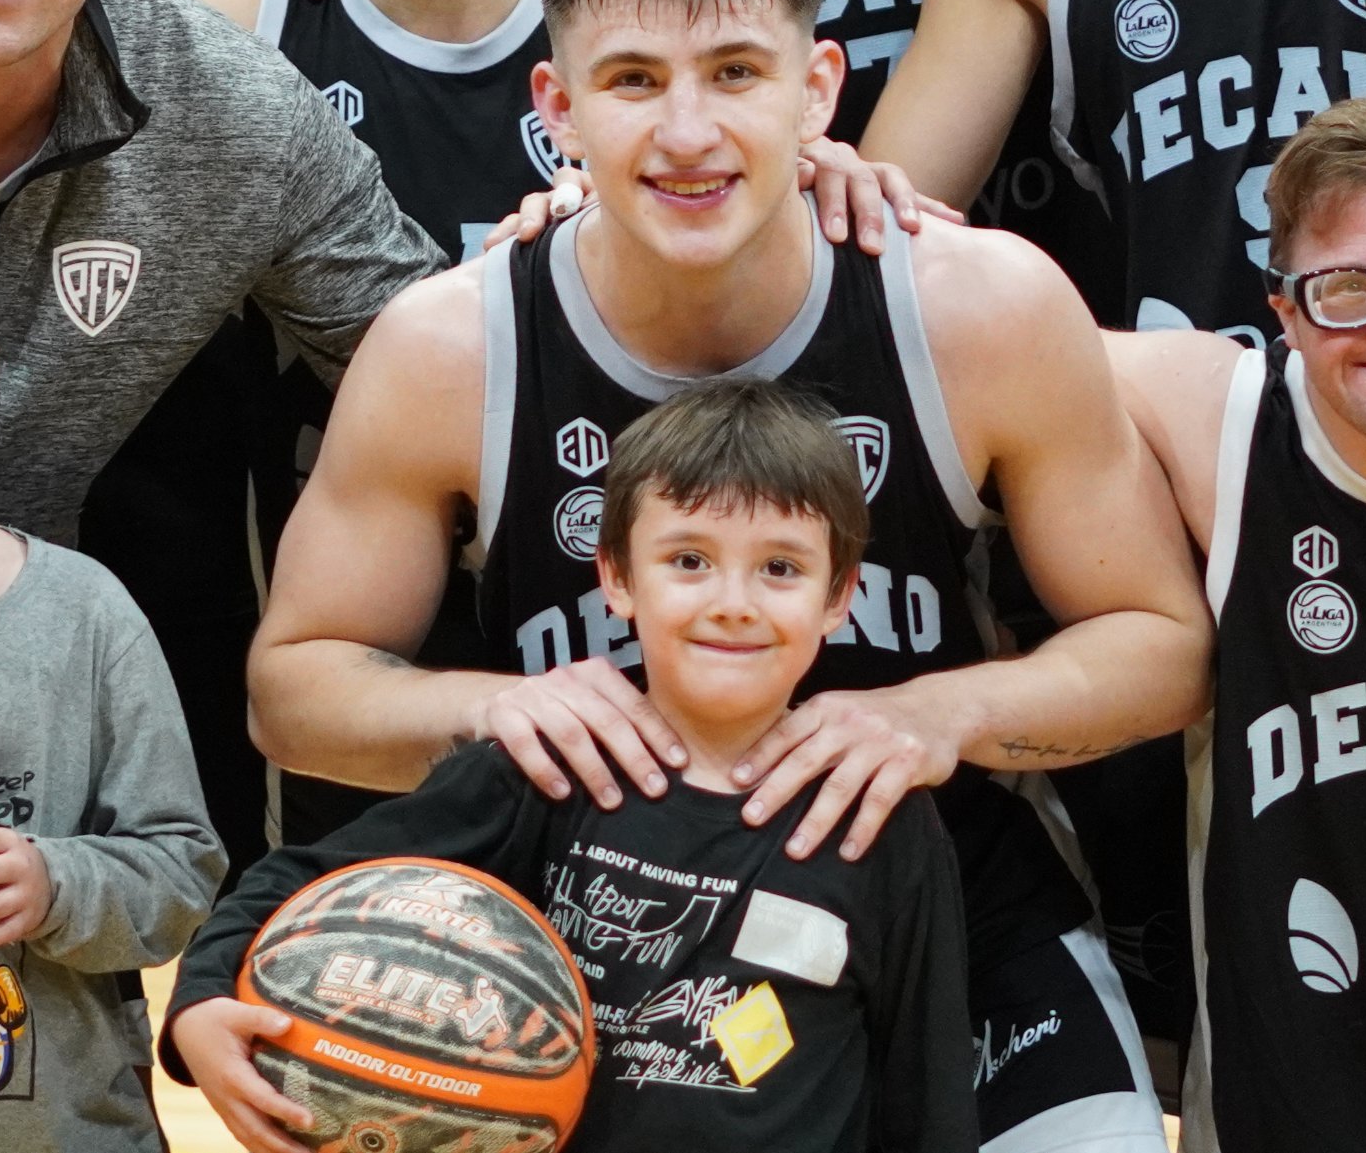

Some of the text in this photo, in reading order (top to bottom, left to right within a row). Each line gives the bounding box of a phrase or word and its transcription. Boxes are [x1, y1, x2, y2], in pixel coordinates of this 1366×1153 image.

[586, 845, 639, 871] ABOUT
[640, 861, 698, 887] HAVING
[701, 875, 738, 893] FUN
[322, 954, 466, 1013] ELITE
[314, 1038, 482, 1097] INDOOR/OUTDOOR
